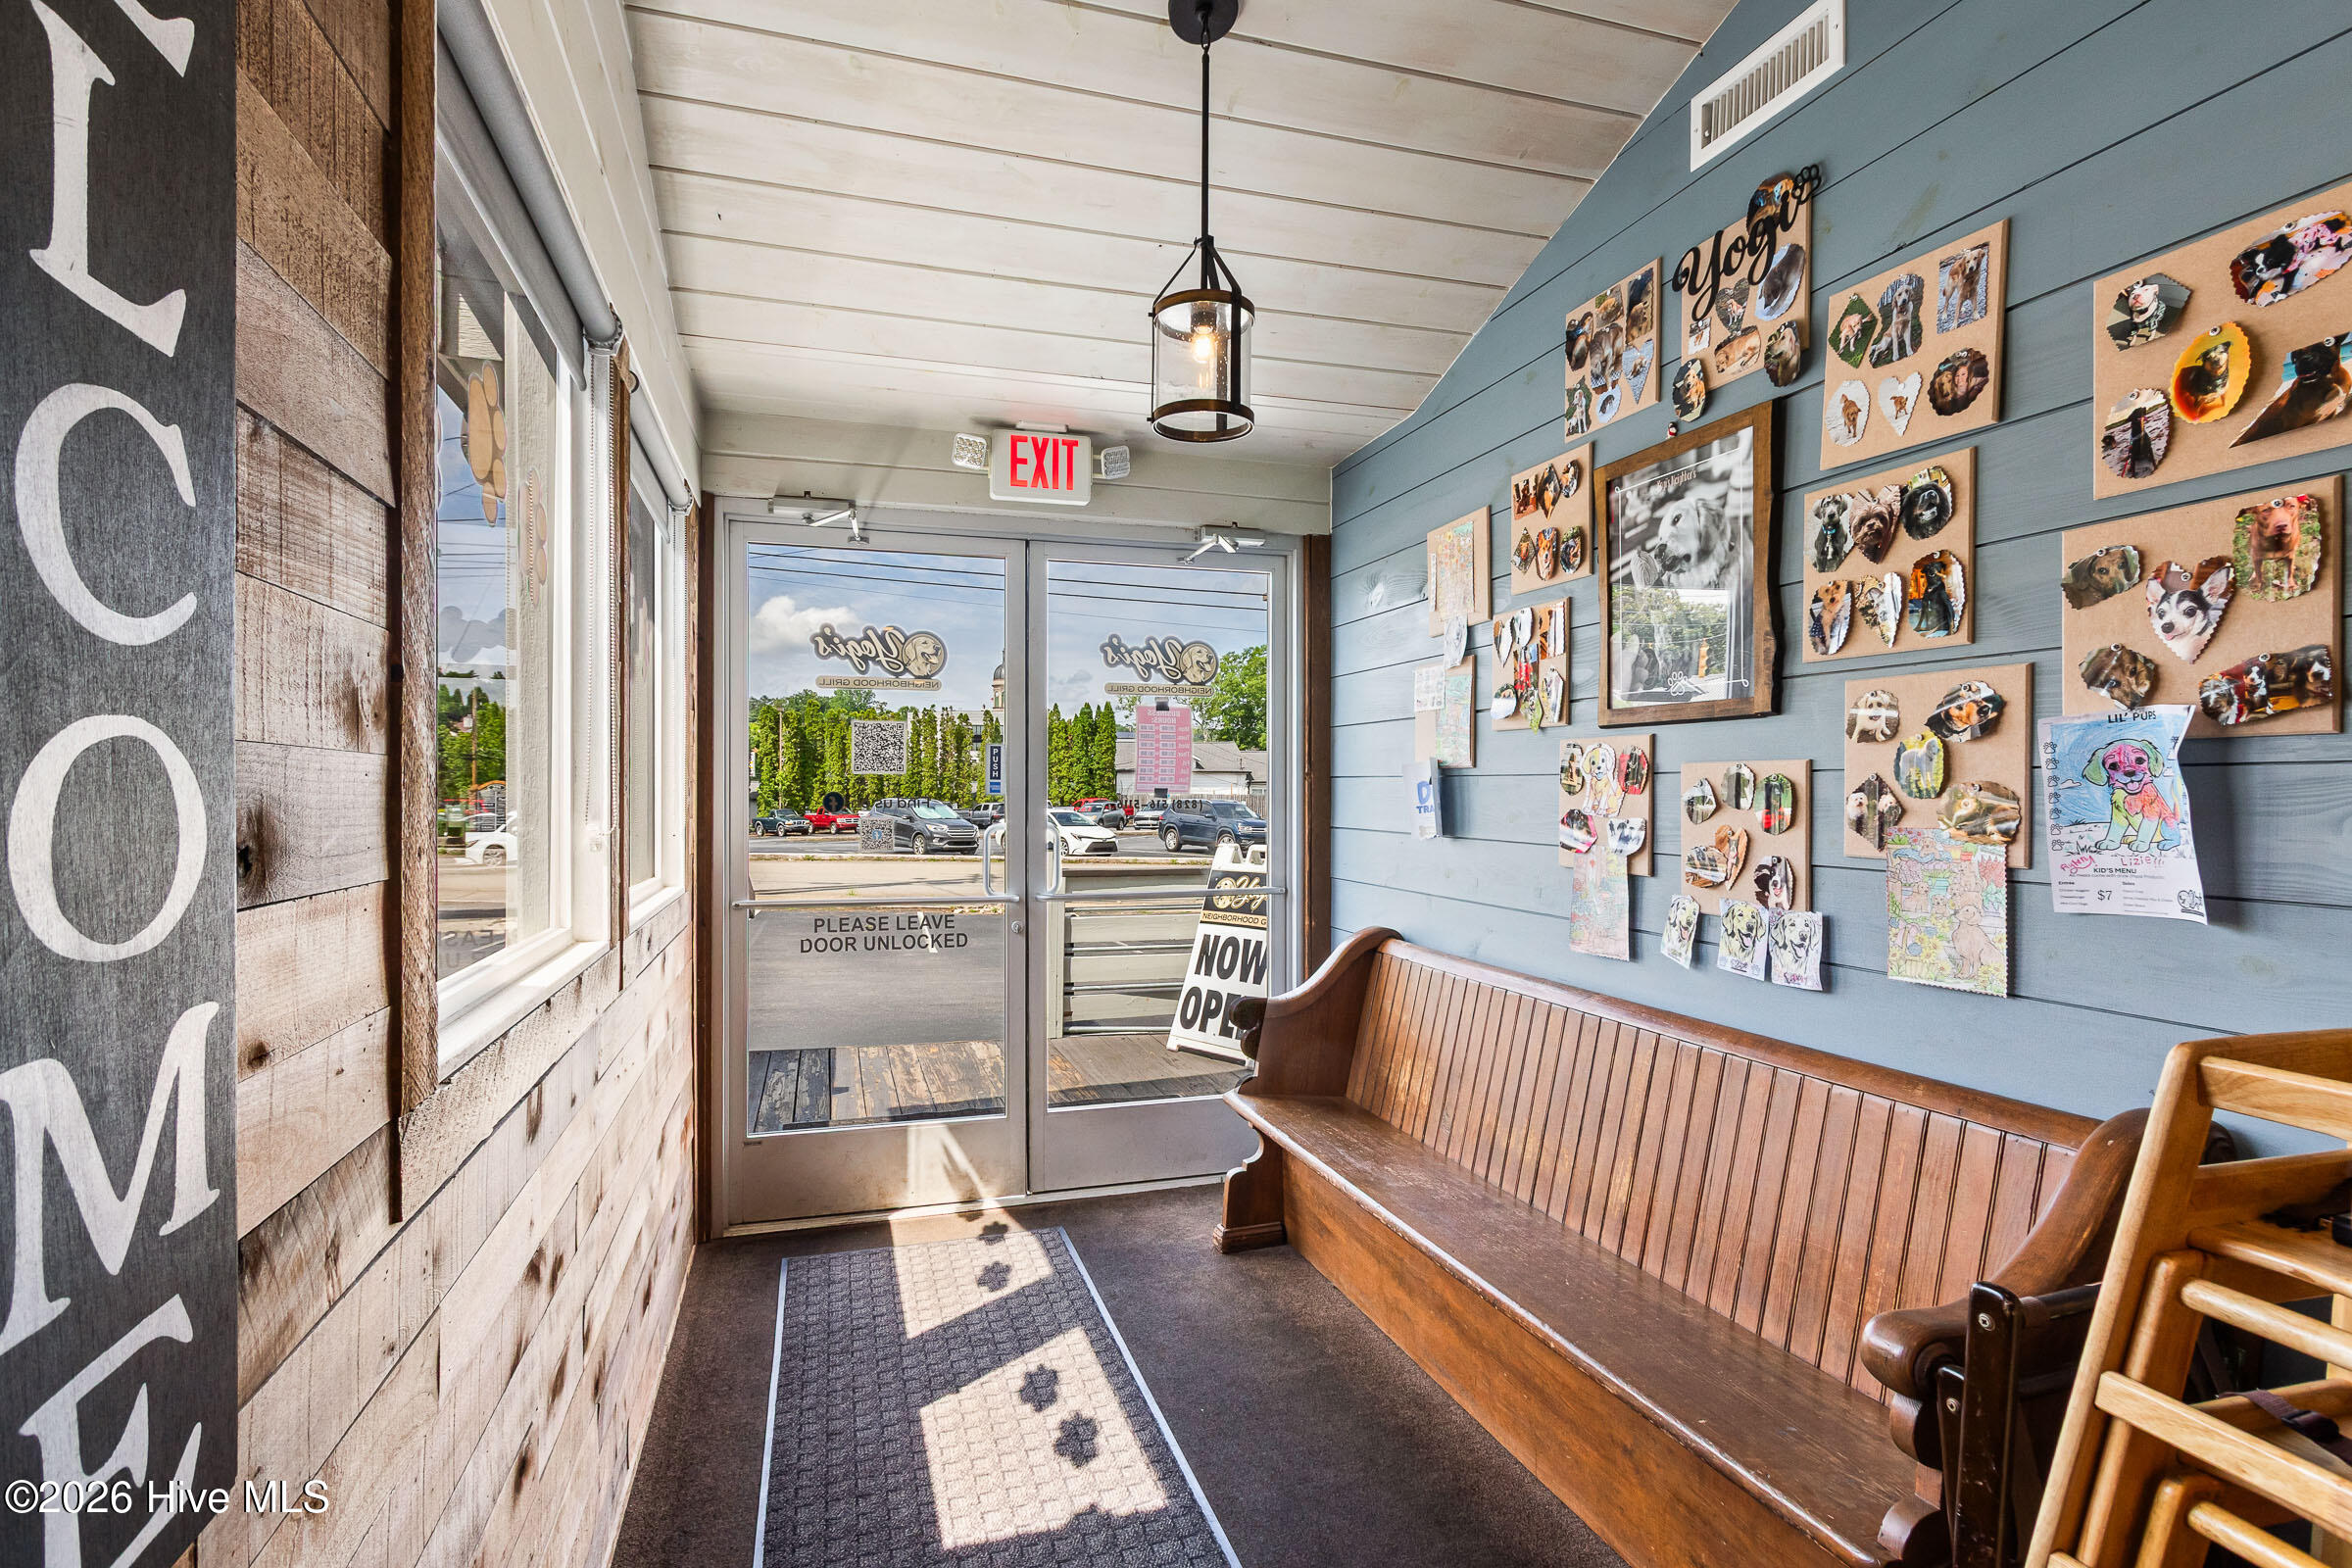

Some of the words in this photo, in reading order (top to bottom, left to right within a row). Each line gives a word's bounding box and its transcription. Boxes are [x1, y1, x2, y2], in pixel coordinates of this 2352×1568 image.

[1671, 186, 1801, 321] Yogi
[1009, 434, 1079, 491] EXIT
[2108, 711, 2129, 724] LIL'
[2132, 710, 2157, 722] PUPS
[2097, 889, 2113, 902] $7
[813, 915, 890, 934] PLEASE
[896, 913, 956, 931] LEAVE
[1201, 912, 1259, 925] NEIGHBORHOOD
[800, 936, 858, 954] DOOR
[863, 932, 968, 952] UNLOCKED
[1194, 933, 1268, 986] NOW
[1179, 986, 1244, 1040] OPE
